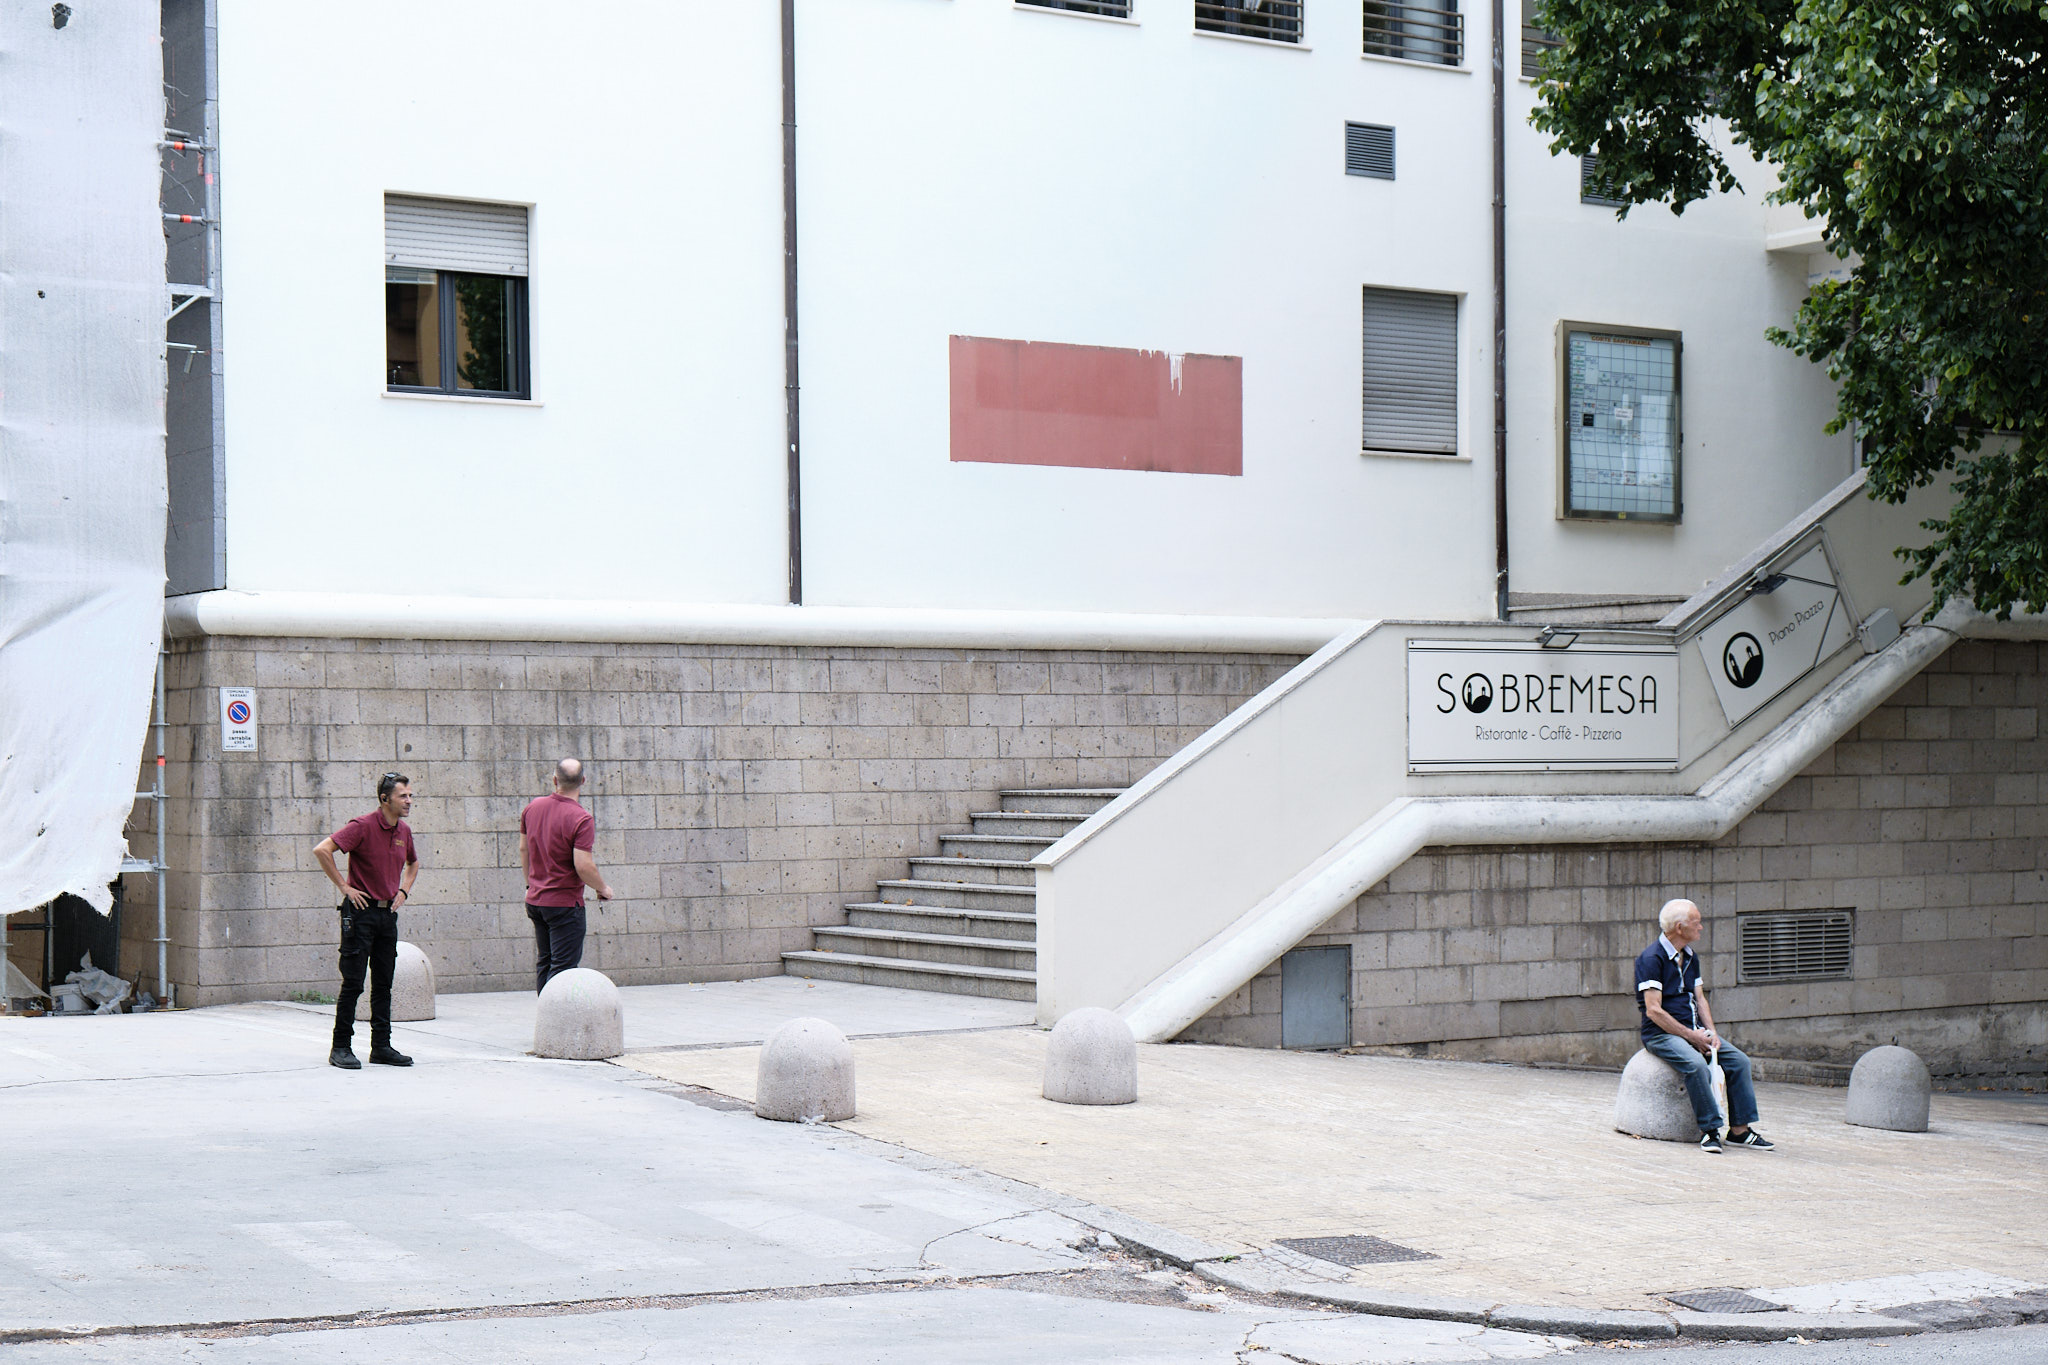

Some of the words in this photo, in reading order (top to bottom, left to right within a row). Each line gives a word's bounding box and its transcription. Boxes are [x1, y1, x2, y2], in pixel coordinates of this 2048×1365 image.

[1768, 622, 1796, 646] Piano
[1794, 599, 1824, 627] Piazza
[1436, 672, 1657, 715] SOBREMESA
[1475, 725, 1528, 741] Ristorante
[1539, 725, 1572, 741] Caffè
[1582, 725, 1622, 741] Pizzeria
